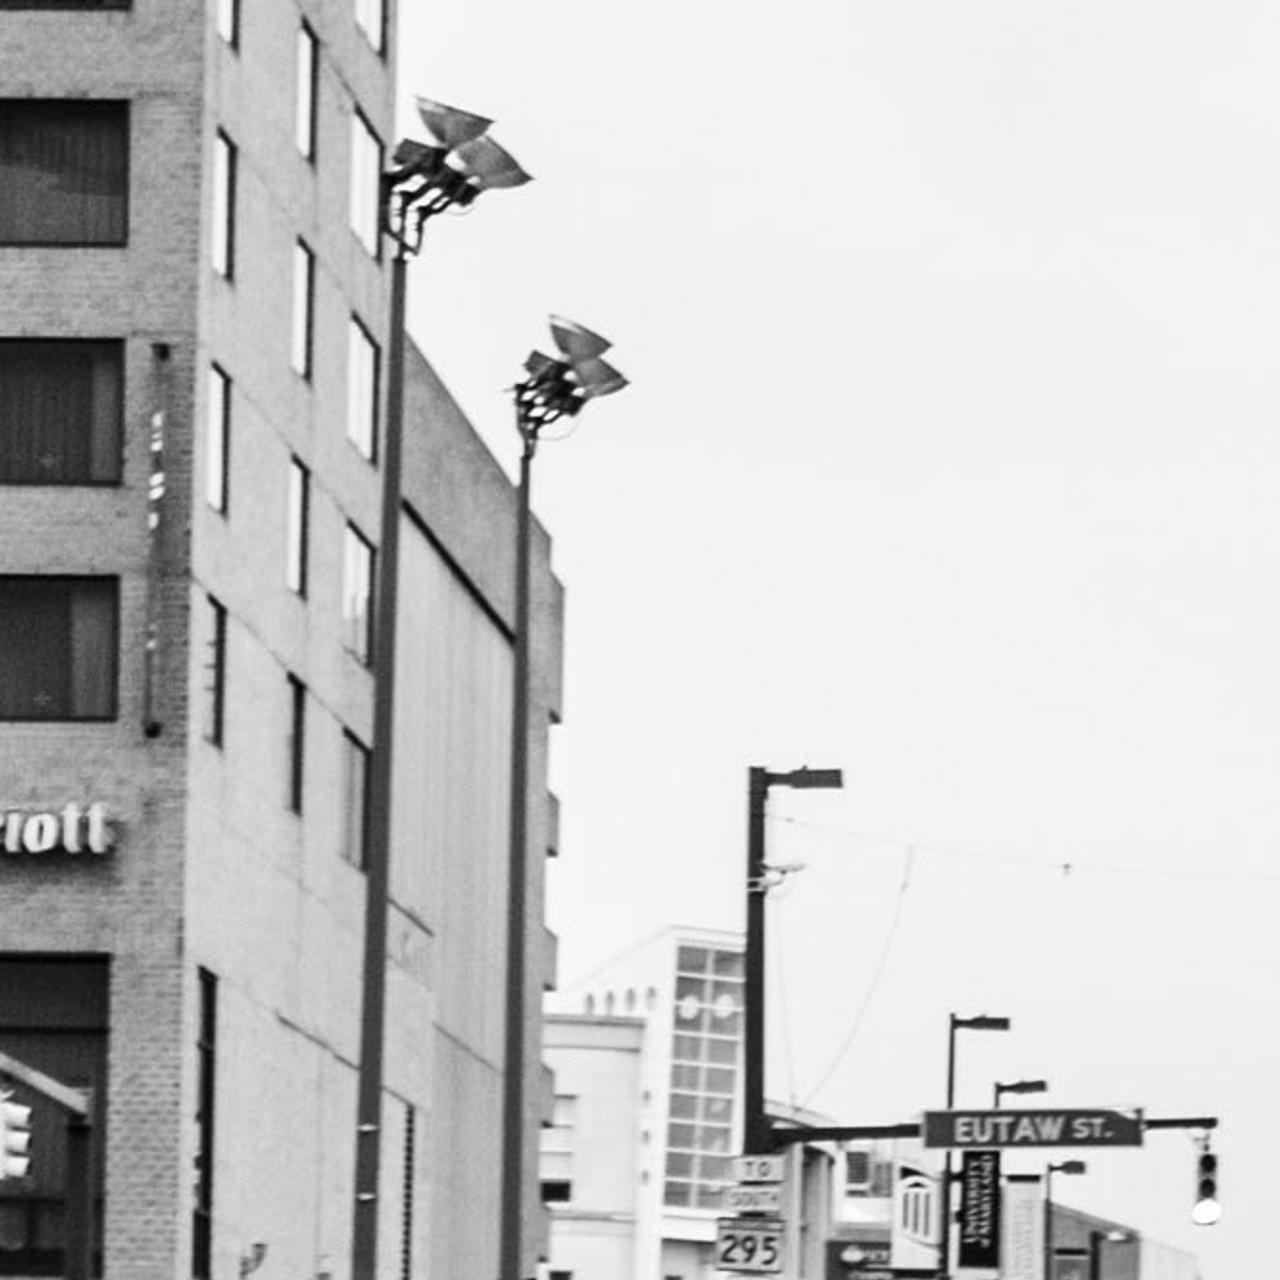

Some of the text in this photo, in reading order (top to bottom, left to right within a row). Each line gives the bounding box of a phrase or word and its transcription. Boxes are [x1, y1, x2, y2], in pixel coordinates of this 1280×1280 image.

[954, 1116, 1115, 1143] EUTAW ST.
[745, 1161, 770, 1178] TO
[721, 1234, 778, 1266] 295
